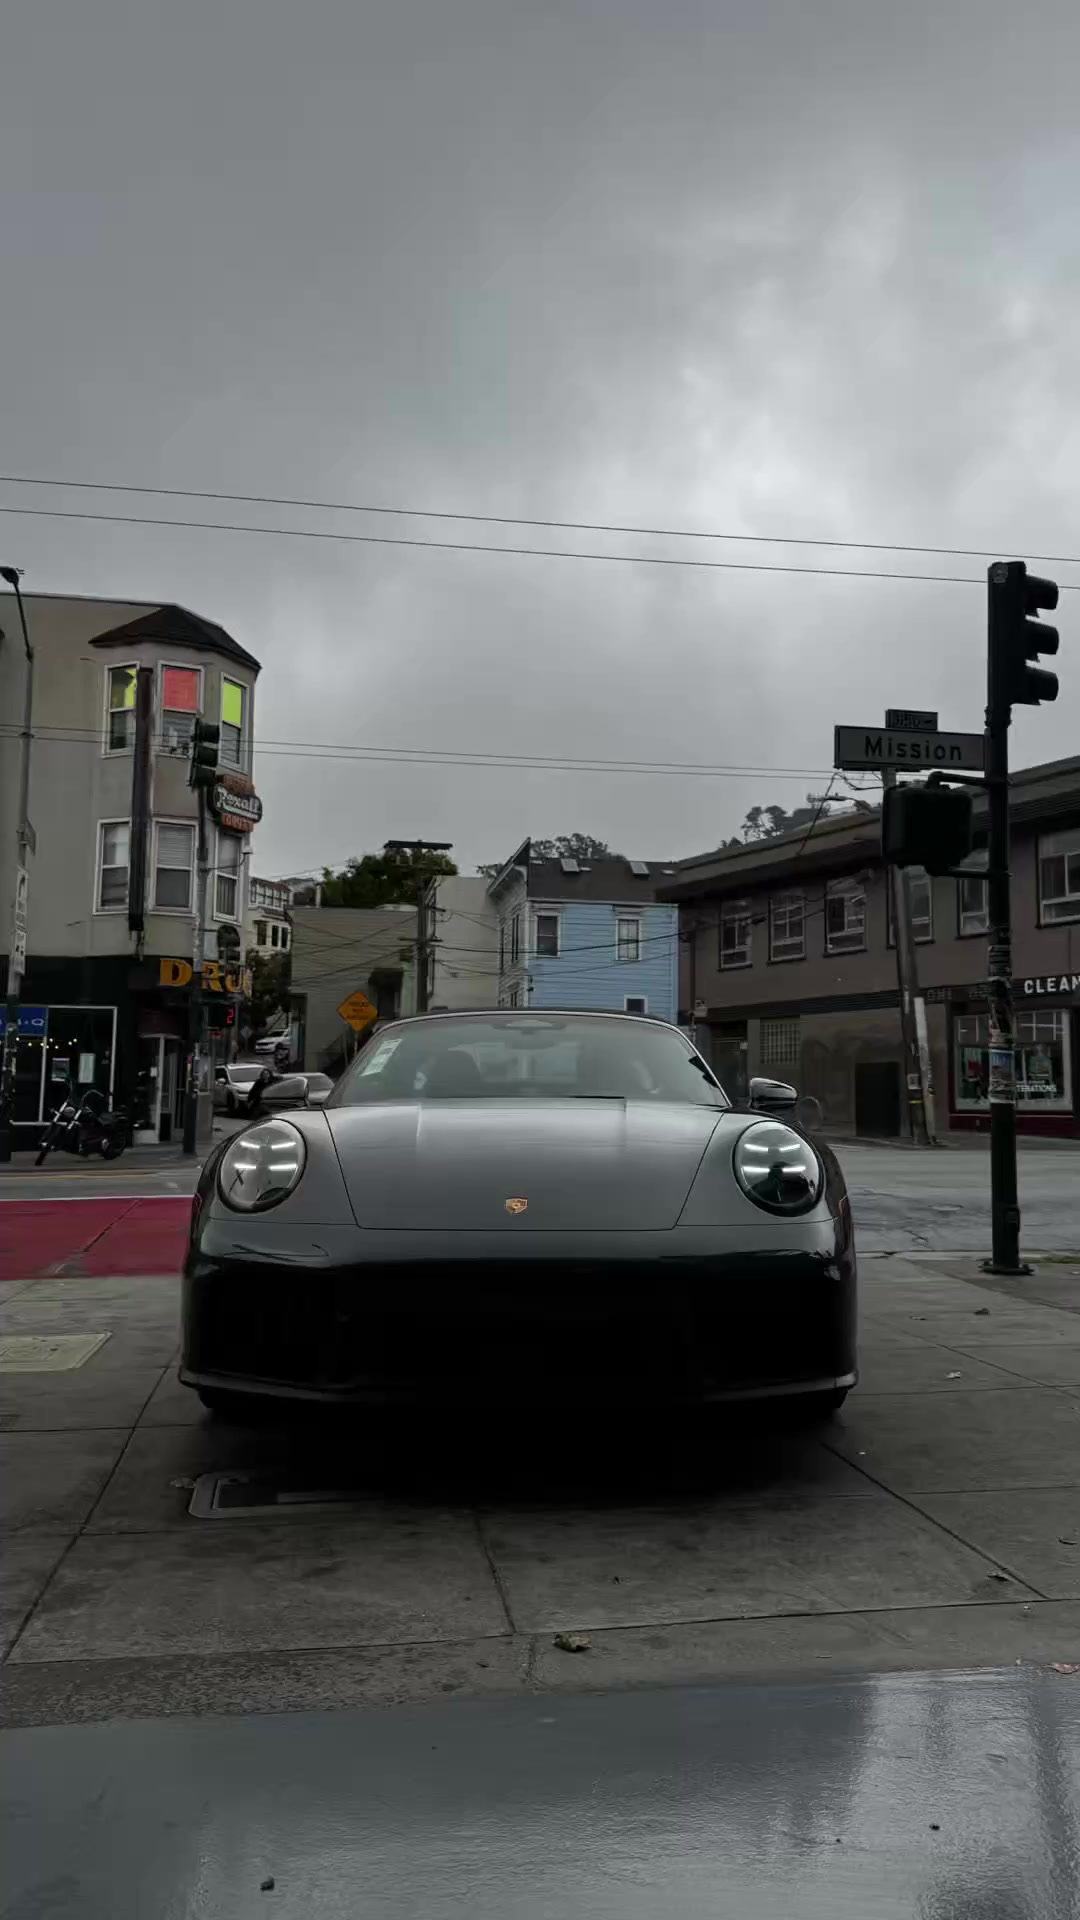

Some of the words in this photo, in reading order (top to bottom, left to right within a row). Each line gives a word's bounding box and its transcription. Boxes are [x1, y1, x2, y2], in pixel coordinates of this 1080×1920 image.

[864, 735, 962, 760] Mission
[216, 786, 258, 813] Rexall
[1024, 975, 1080, 994] CLEAN
